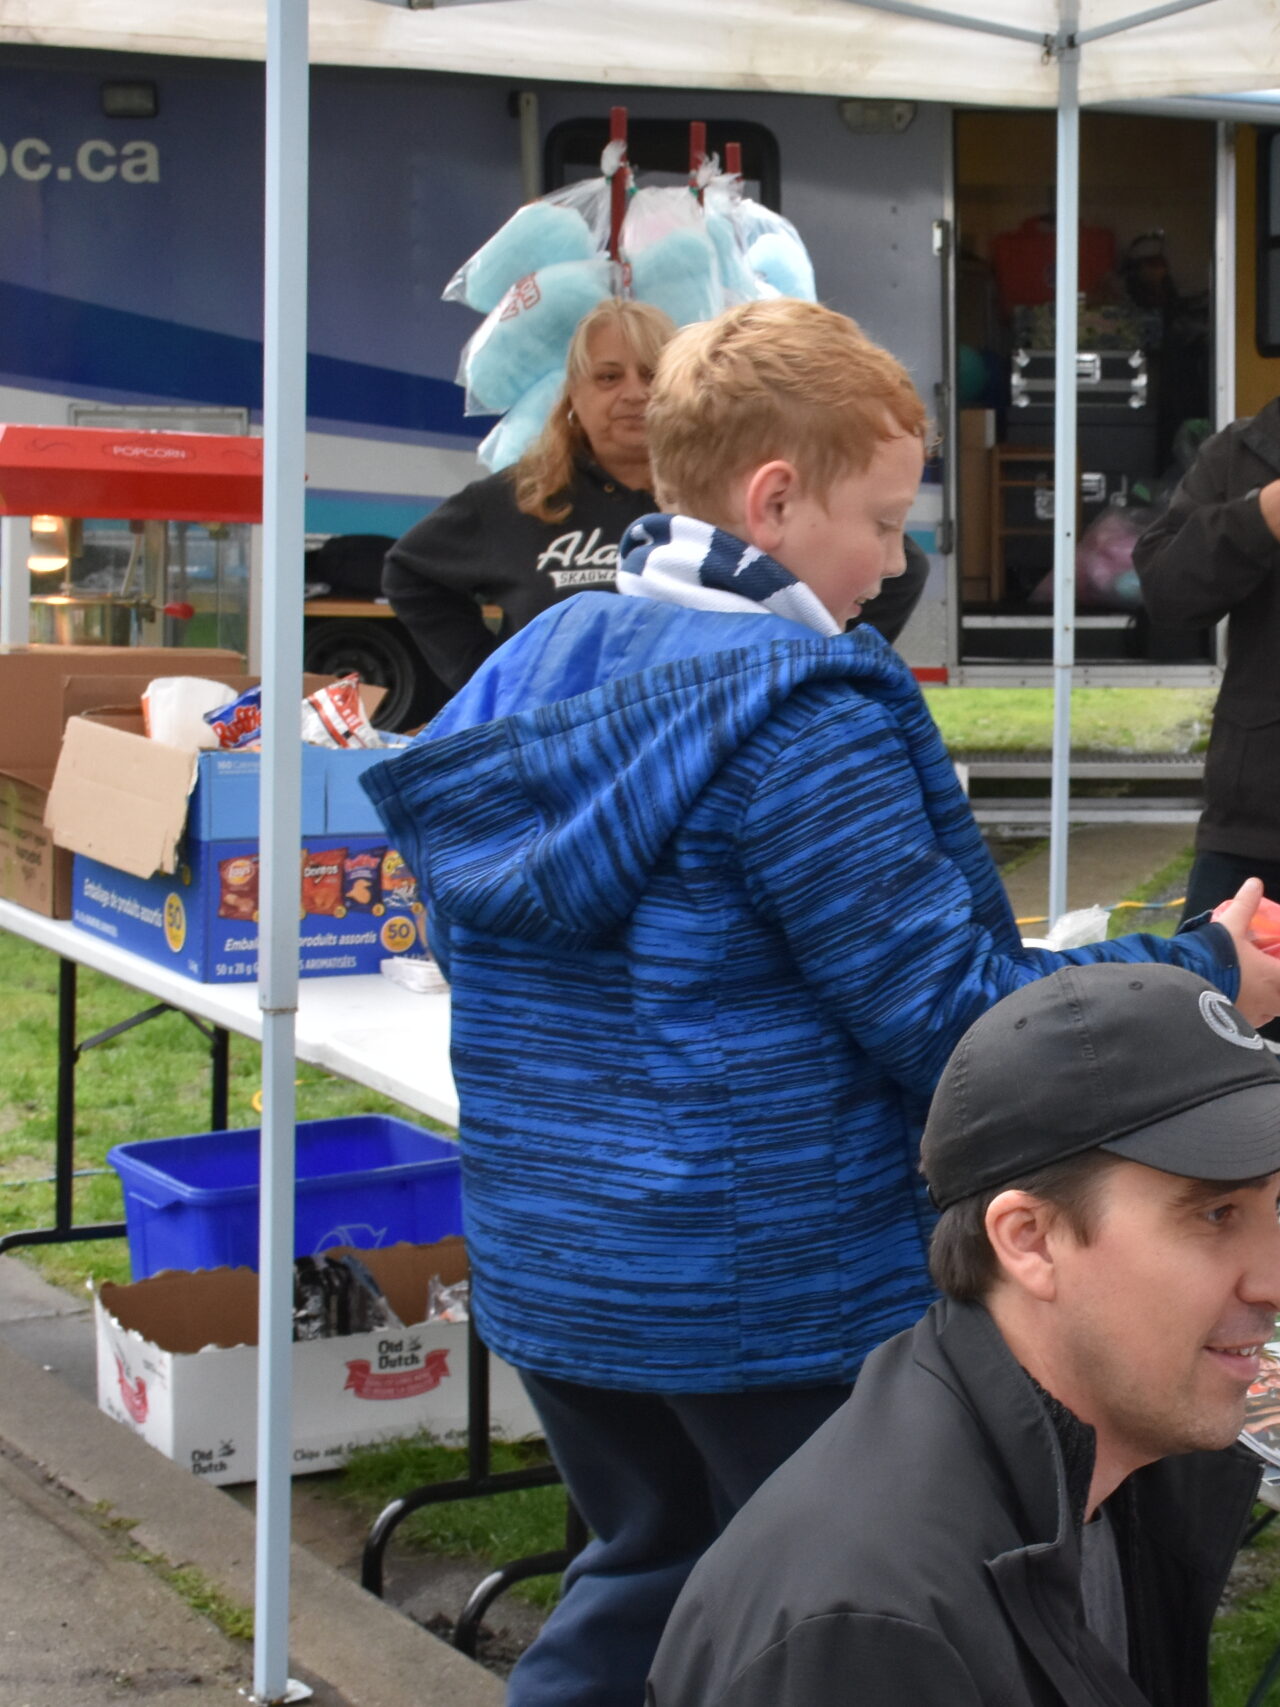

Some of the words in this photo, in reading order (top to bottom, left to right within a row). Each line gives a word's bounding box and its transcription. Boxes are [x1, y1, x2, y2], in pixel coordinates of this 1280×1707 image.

[0, 137, 161, 184] c.ca
[112, 445, 187, 459] POPCORN
[536, 527, 620, 571] Ala
[387, 922, 411, 939] 50
[378, 1339, 403, 1355] Old
[378, 1352, 422, 1370] Dutch
[191, 1449, 214, 1463] Old
[192, 1461, 229, 1476] Dutch
